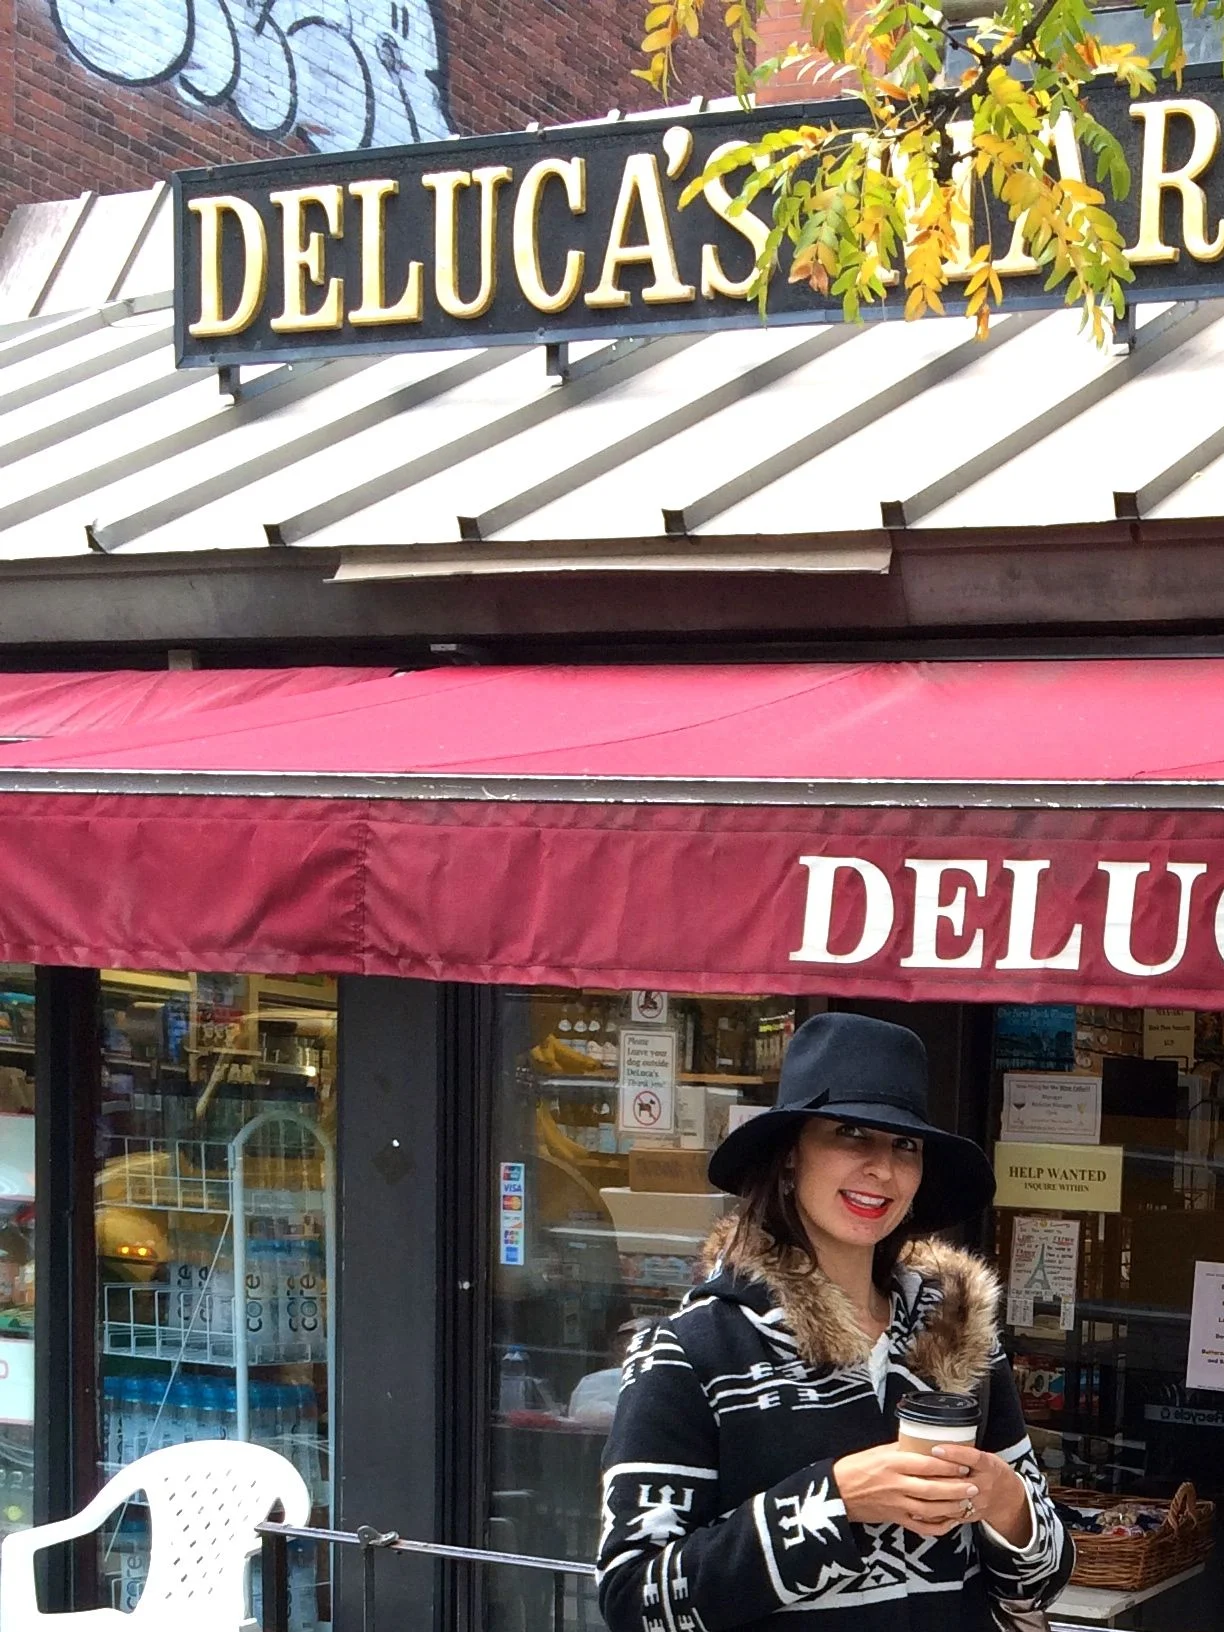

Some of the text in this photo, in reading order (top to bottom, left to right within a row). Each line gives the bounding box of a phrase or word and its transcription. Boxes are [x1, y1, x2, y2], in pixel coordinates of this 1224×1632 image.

[188, 126, 774, 338] DELUCA'S
[504, 1184, 522, 1192] VISA
[1009, 1166, 1107, 1182] HELP WANTED
[1024, 1182, 1089, 1192] INQUIRE WITHIN
[246, 1274, 263, 1332] core
[300, 1274, 318, 1331] core
